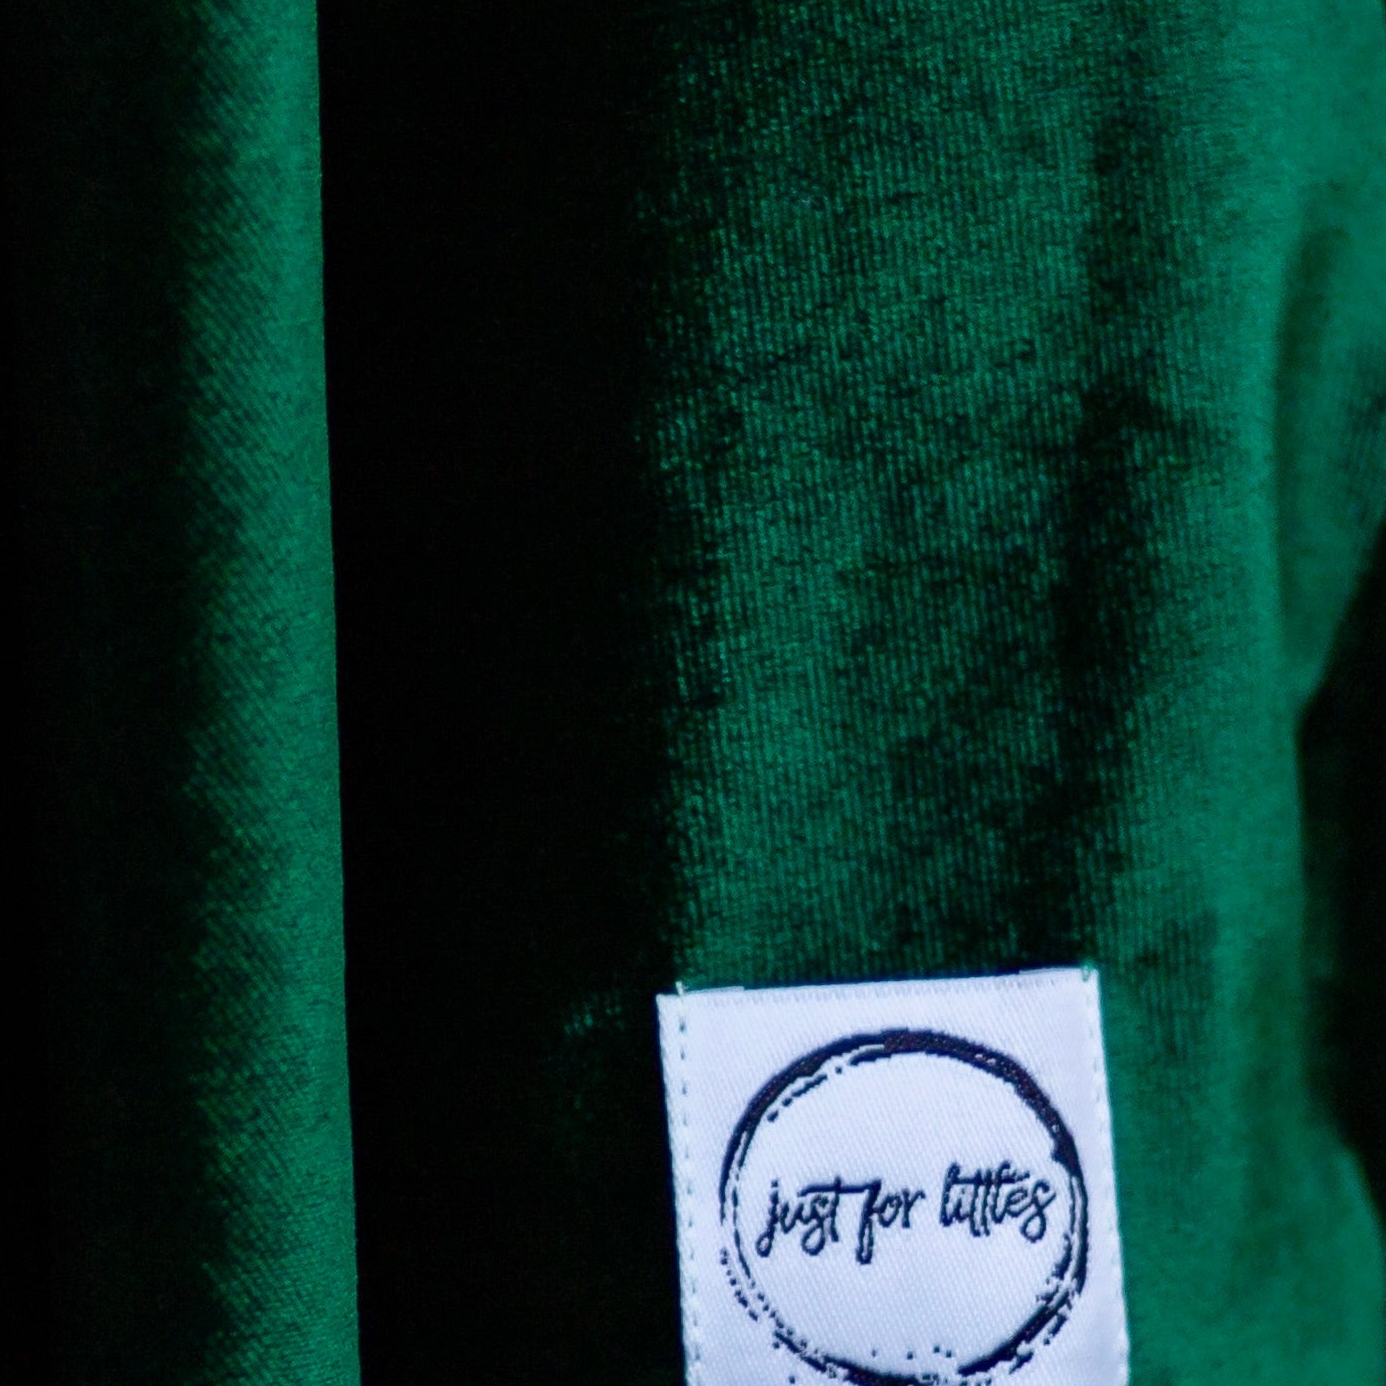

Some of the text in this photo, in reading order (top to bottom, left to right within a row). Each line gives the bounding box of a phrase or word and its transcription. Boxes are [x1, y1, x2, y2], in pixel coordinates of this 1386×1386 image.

[755, 1161, 1057, 1265] just for littles
